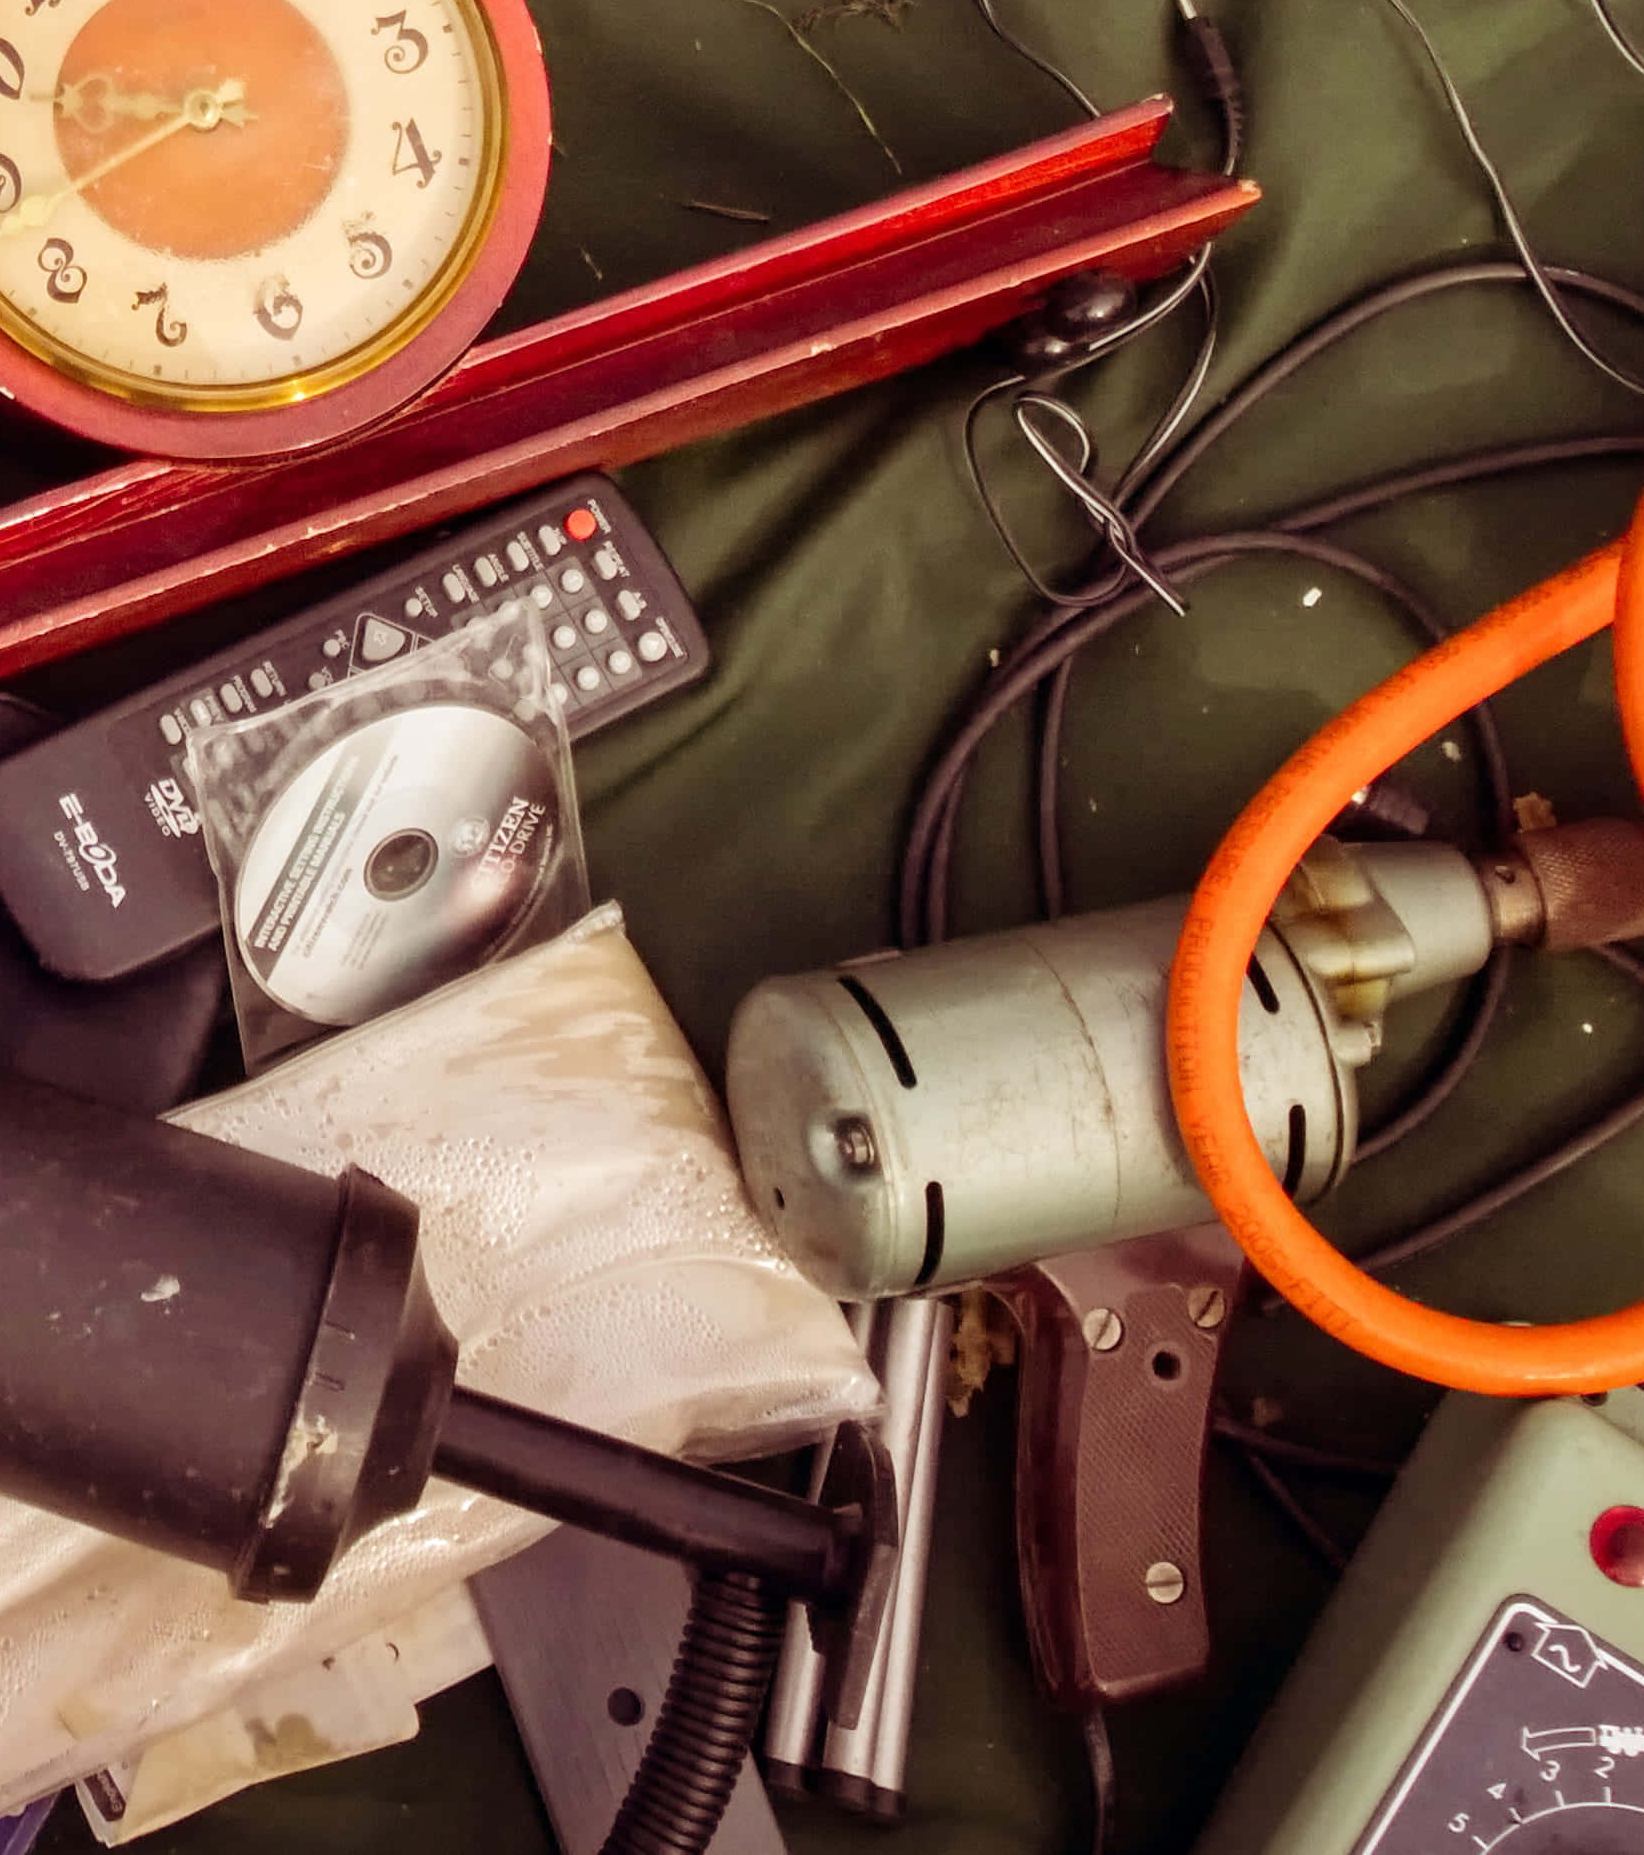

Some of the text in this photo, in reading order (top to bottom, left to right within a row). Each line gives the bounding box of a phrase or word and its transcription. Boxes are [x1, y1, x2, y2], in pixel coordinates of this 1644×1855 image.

[370, 9, 429, 74] 3
[390, 117, 443, 189] 4
[37, 237, 88, 305] 8
[131, 282, 188, 347] 7
[253, 273, 304, 342] 6
[587, 499, 611, 534] POWER
[144, 792, 171, 837] VIDEO
[157, 778, 201, 835] DVD
[58, 793, 127, 909] E-BODA
[471, 796, 531, 893] ITIZEN
[266, 923, 288, 952] AND
[309, 810, 347, 868] MANUALS
[1487, 1778, 1507, 1801] 4
[1541, 1760, 1562, 1783] 3
[1595, 1756, 1616, 1779] 2
[1448, 1812, 1470, 1835] 5
